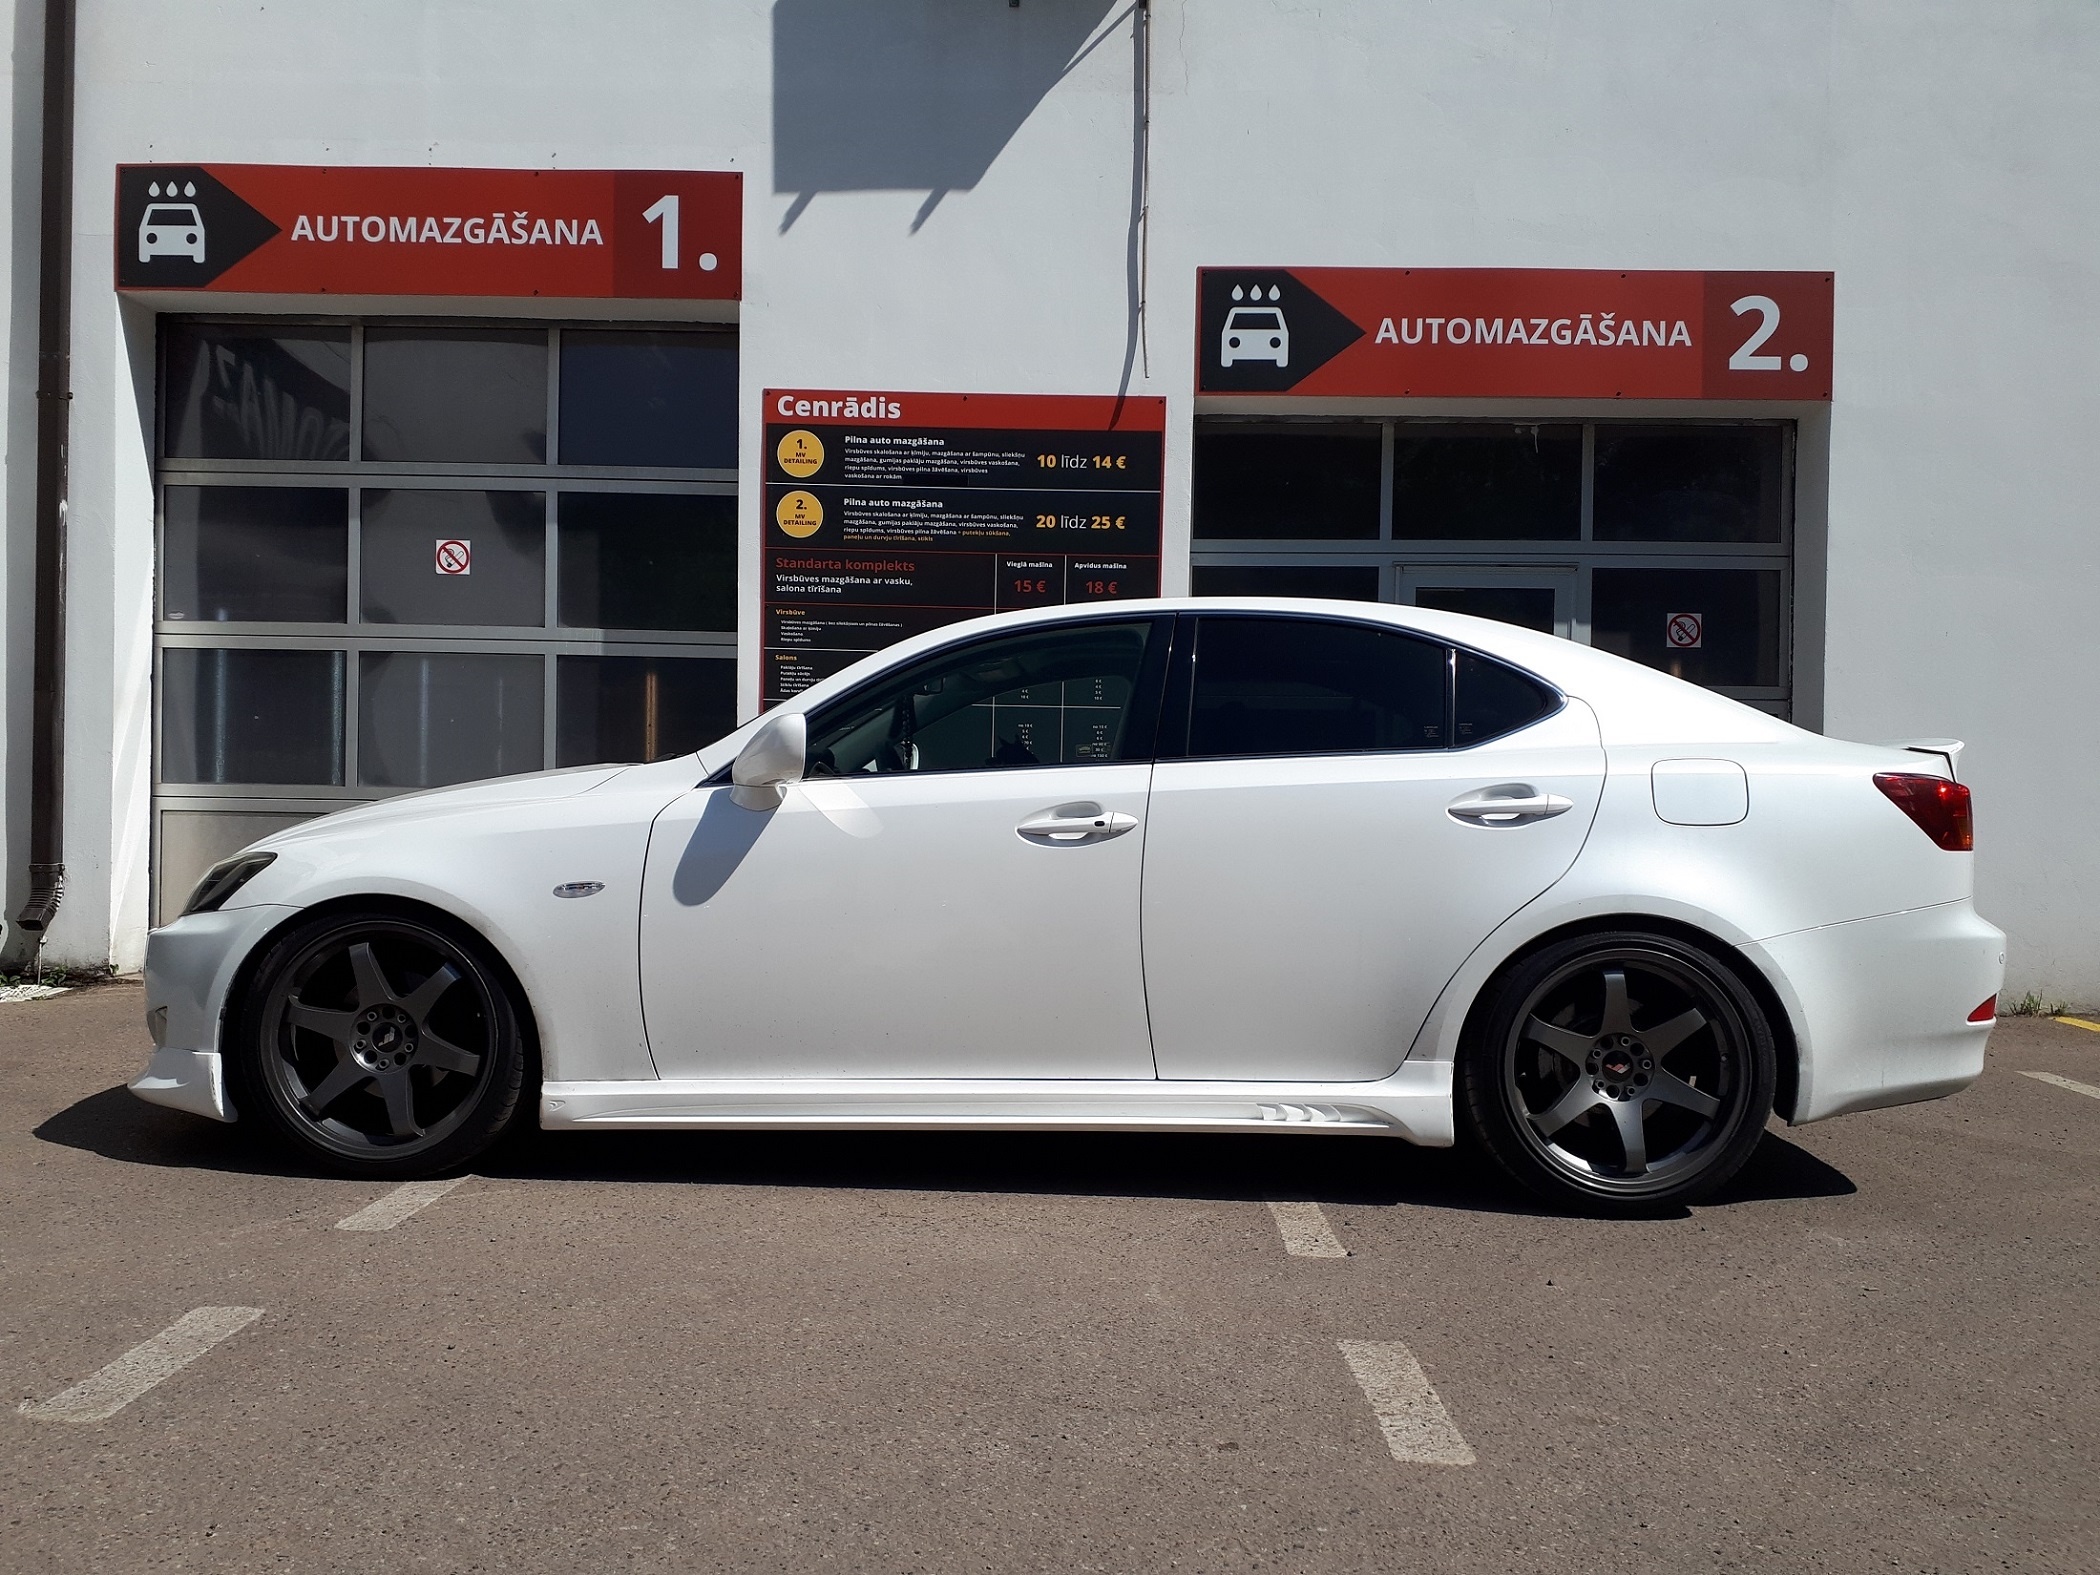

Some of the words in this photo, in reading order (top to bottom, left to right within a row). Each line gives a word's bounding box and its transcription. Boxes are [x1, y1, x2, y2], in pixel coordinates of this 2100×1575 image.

[290, 211, 604, 246] AUTOMAZGĀŠANA
[642, 194, 718, 271] 1.
[1374, 312, 1692, 348] AUTOMAZGĀŠANA
[1728, 295, 1808, 373] 2.
[777, 395, 901, 419] Cenrādis
[796, 438, 807, 450] 1.
[844, 435, 868, 444] Pilna
[892, 437, 945, 447] mazgāšana
[1037, 454, 1057, 468] 10
[1061, 454, 1087, 469] līdz
[1092, 455, 1112, 469] 14
[1116, 456, 1127, 469] €
[796, 499, 807, 510] 2.
[843, 498, 867, 506] Pilna
[868, 499, 890, 507] auto
[891, 499, 943, 509] mazgāšana
[1036, 514, 1056, 529] 20
[1060, 514, 1087, 529] līdz
[1091, 516, 1111, 529] 25
[1115, 516, 1126, 530] €
[775, 557, 842, 570] Standarta
[845, 558, 915, 573] komplekts
[1006, 560, 1027, 569] Vieglā
[1074, 562, 1102, 570] Apvidus
[776, 574, 820, 583] Virsbūves
[821, 575, 871, 586] mazgāšana
[872, 577, 883, 585] ar
[884, 577, 913, 586] vasku,
[775, 584, 806, 593] salona
[807, 585, 842, 594] tīrīšana
[1014, 580, 1032, 593] 15
[1036, 580, 1046, 593] €
[1085, 581, 1104, 594] 18
[1107, 581, 1118, 594] €
